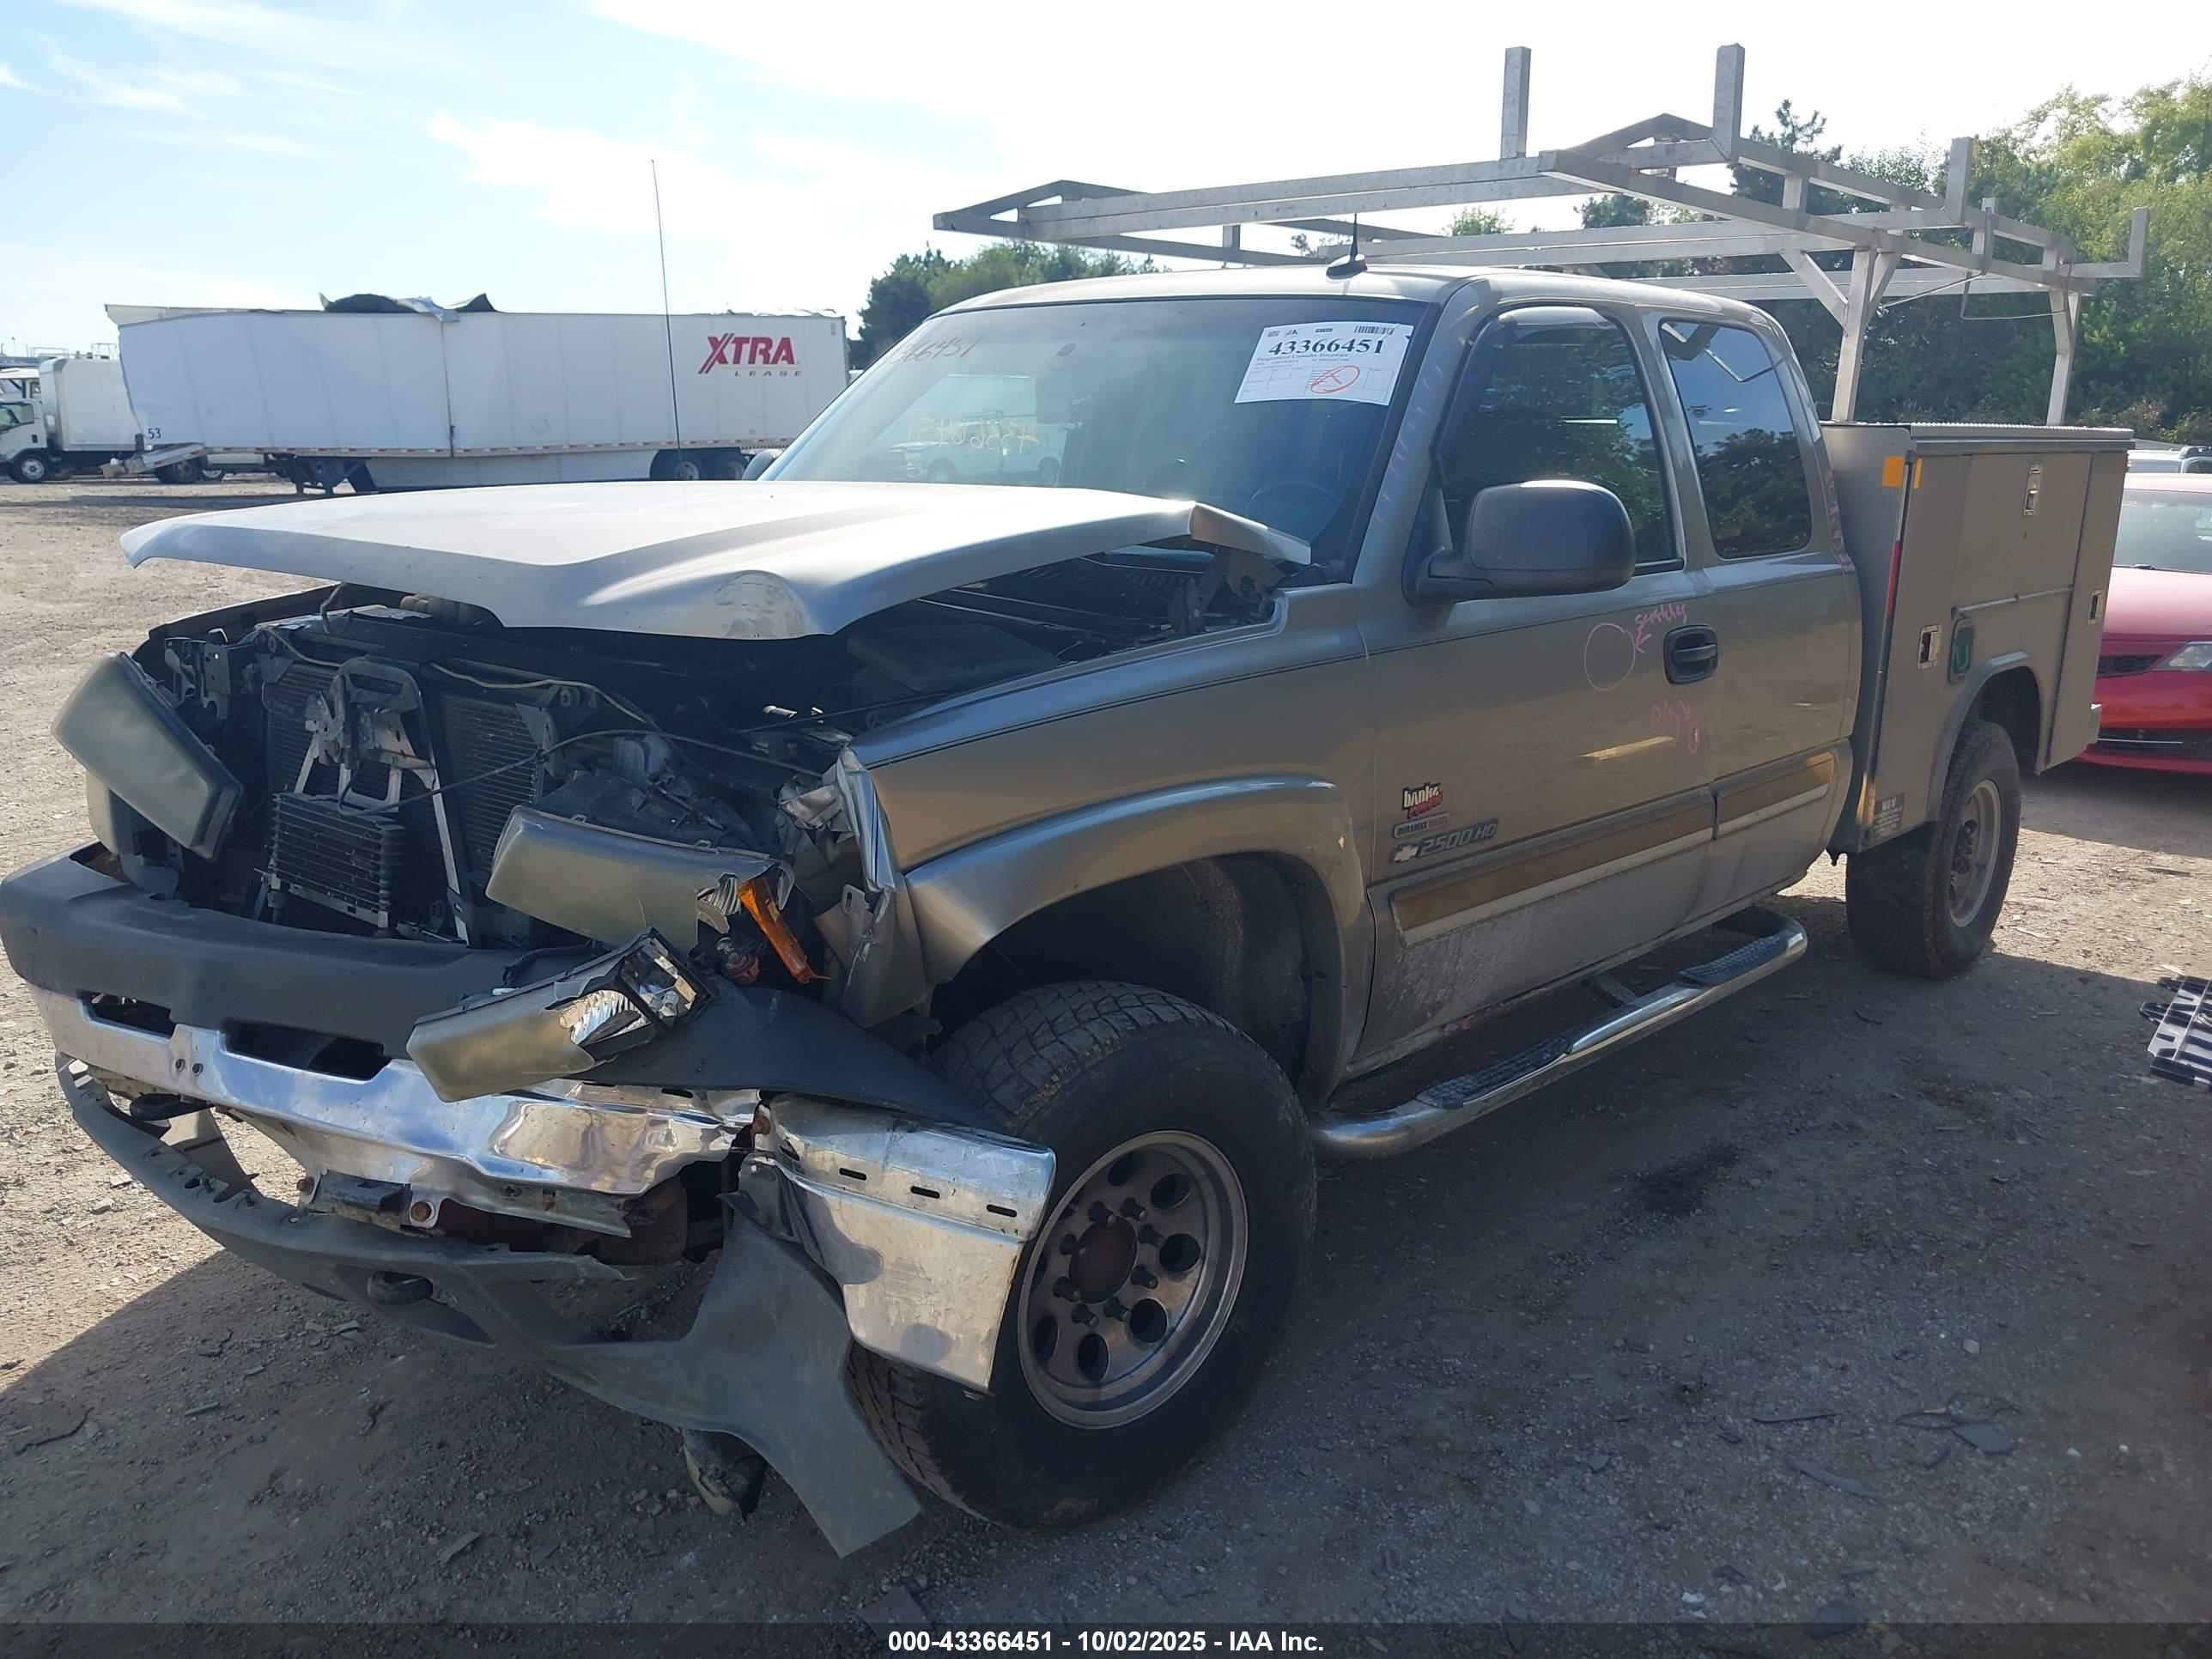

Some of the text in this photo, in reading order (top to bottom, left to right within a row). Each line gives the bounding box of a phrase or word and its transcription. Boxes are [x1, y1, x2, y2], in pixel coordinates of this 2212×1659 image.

[698, 333, 795, 374] XTRA
[1267, 337, 1384, 356] 43366451
[148, 428, 161, 440] 53
